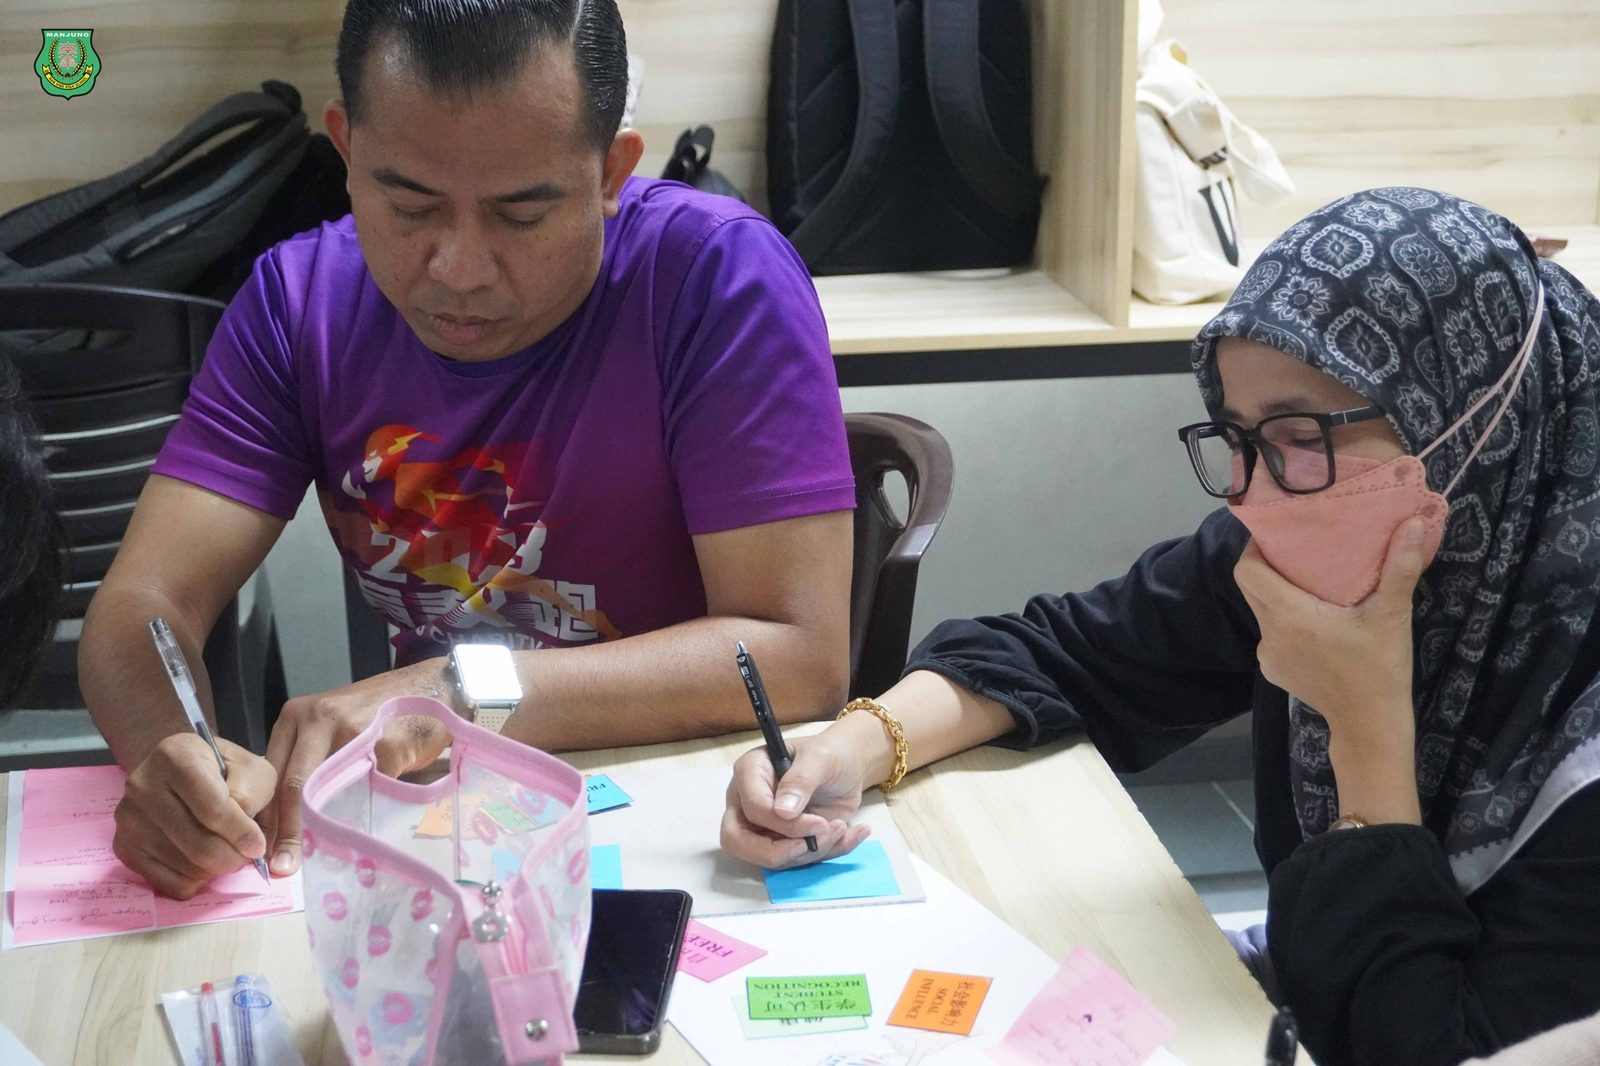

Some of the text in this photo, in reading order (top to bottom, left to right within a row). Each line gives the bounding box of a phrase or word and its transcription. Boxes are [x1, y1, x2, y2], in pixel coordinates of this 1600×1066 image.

[754, 980, 860, 989] RECOGNITION
[775, 990, 844, 998] STUDENT
[764, 998, 857, 1012] 学生认可
[905, 978, 935, 1020] INFLUENCE
[926, 987, 948, 1014] SOCIAL
[940, 981, 975, 1026] 社会影响力
